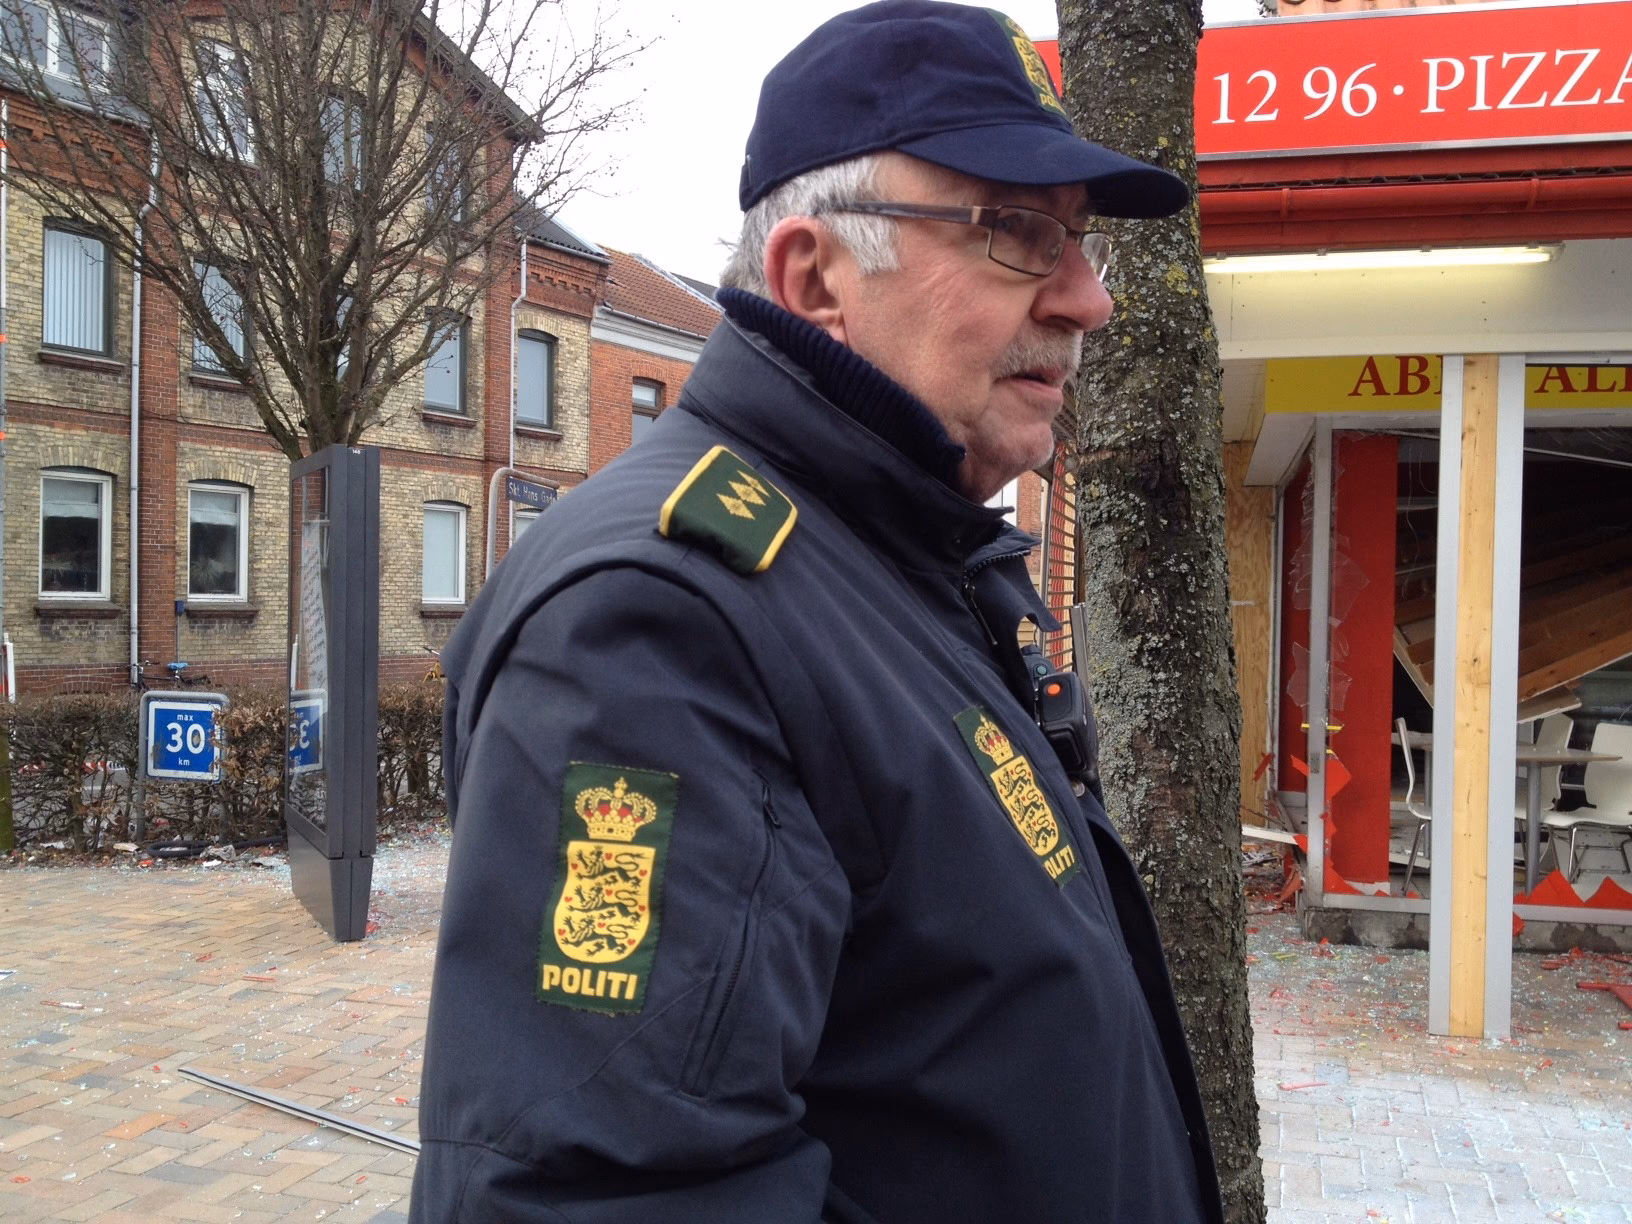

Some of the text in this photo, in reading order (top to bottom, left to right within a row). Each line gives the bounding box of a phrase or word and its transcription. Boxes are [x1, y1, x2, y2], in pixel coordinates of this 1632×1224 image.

[1211, 69, 1279, 124] 12
[1302, 63, 1378, 120] 96
[1348, 355, 1443, 397] AB
[166, 722, 205, 755] 30
[178, 757, 190, 766] km
[1044, 844, 1075, 879] OLITI
[542, 964, 638, 1000] POLITI
